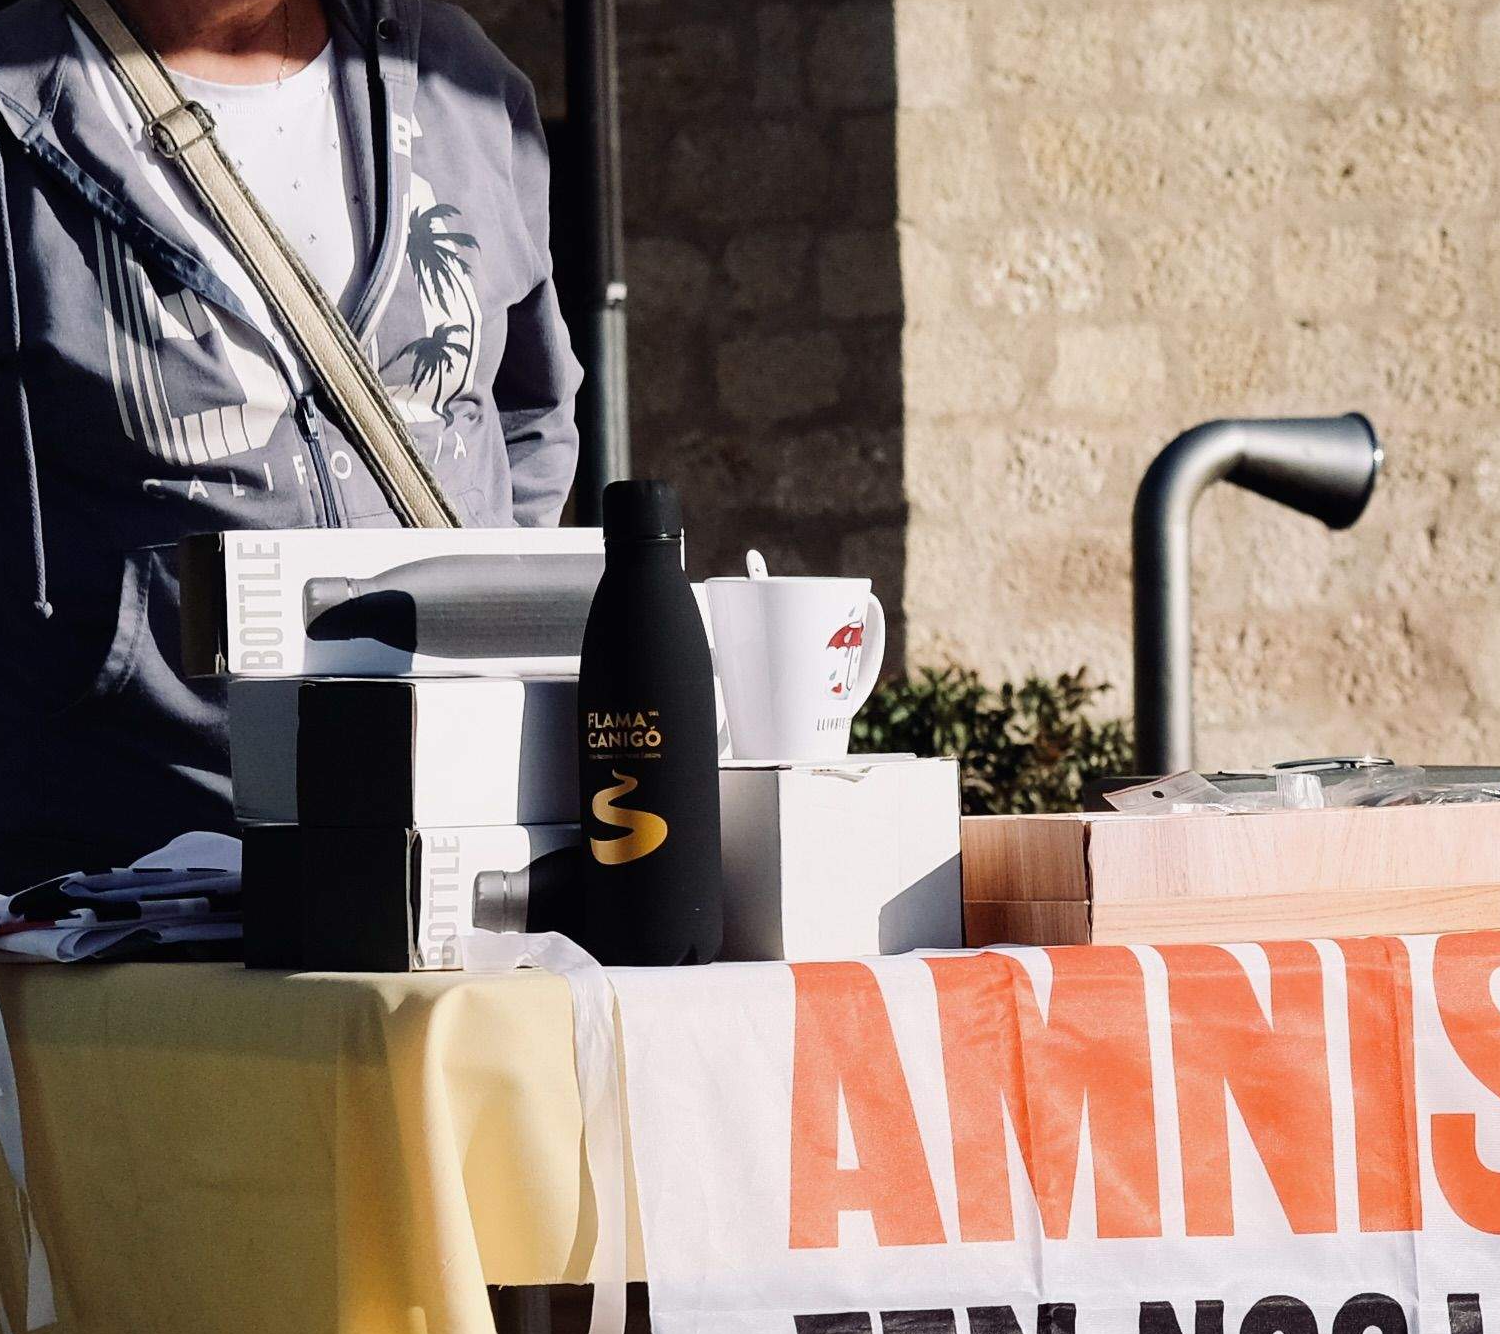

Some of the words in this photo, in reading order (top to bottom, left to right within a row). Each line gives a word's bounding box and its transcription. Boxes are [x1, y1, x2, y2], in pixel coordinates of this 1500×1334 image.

[141, 431, 468, 501] CALIFOIA
[237, 542, 283, 670] BOTTLE
[588, 712, 647, 728] FLAMA
[588, 725, 662, 748] CANIGÓ
[427, 836, 460, 965] BOTTLE
